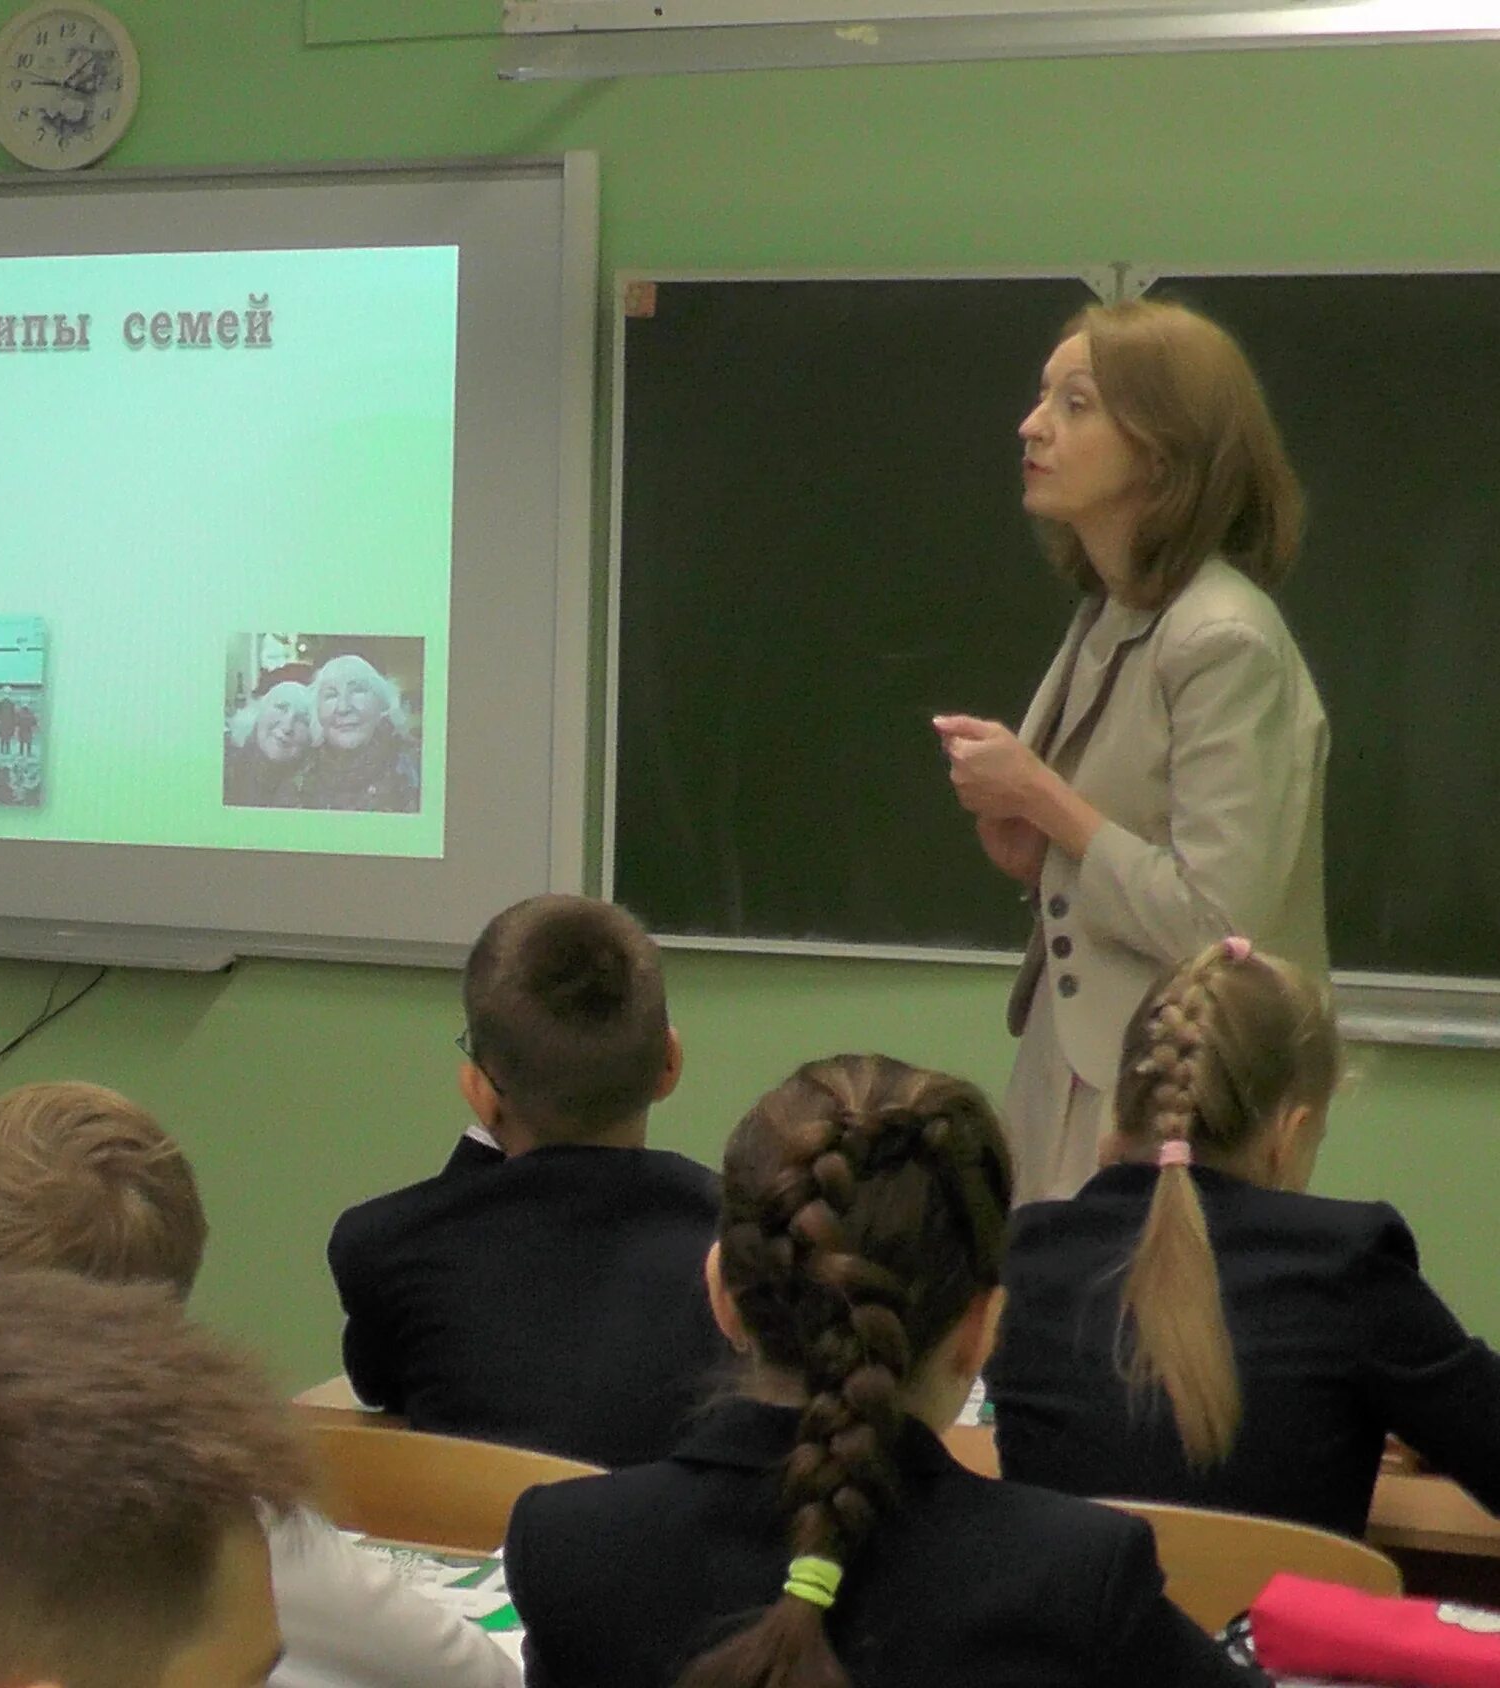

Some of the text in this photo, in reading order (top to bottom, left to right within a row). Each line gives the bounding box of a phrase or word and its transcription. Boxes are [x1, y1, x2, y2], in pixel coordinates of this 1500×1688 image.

[59, 22, 77, 38] 12
[36, 31, 48, 46] 11
[17, 53, 33, 69] 10
[122, 291, 274, 349] семей
